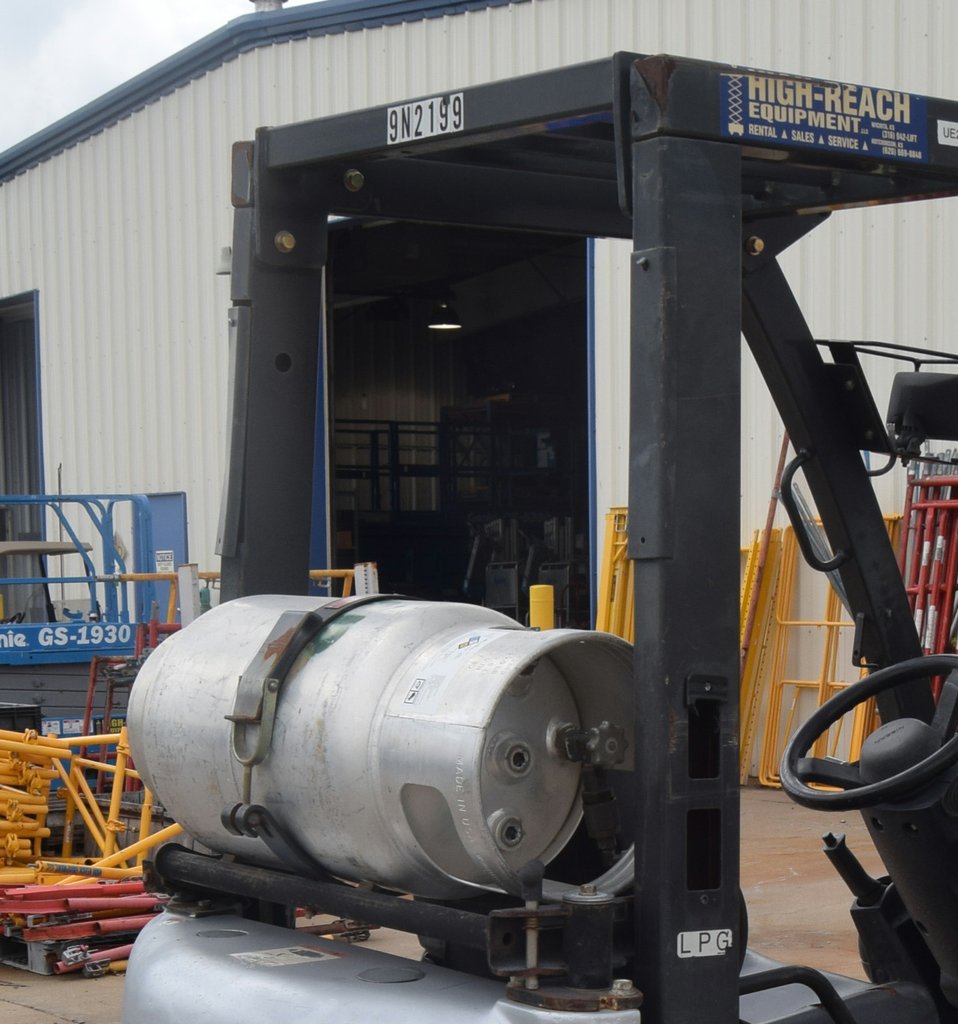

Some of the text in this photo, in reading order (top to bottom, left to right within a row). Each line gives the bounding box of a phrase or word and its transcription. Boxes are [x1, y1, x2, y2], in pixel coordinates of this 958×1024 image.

[749, 74, 911, 124] HIGH-REACH
[389, 95, 462, 142] 9N2199
[749, 102, 861, 133] EQUIPMENT
[749, 125, 859, 150] RENTAL SALES SERVICE
[38, 625, 131, 646] GS-1930
[680, 931, 730, 954] LPG
